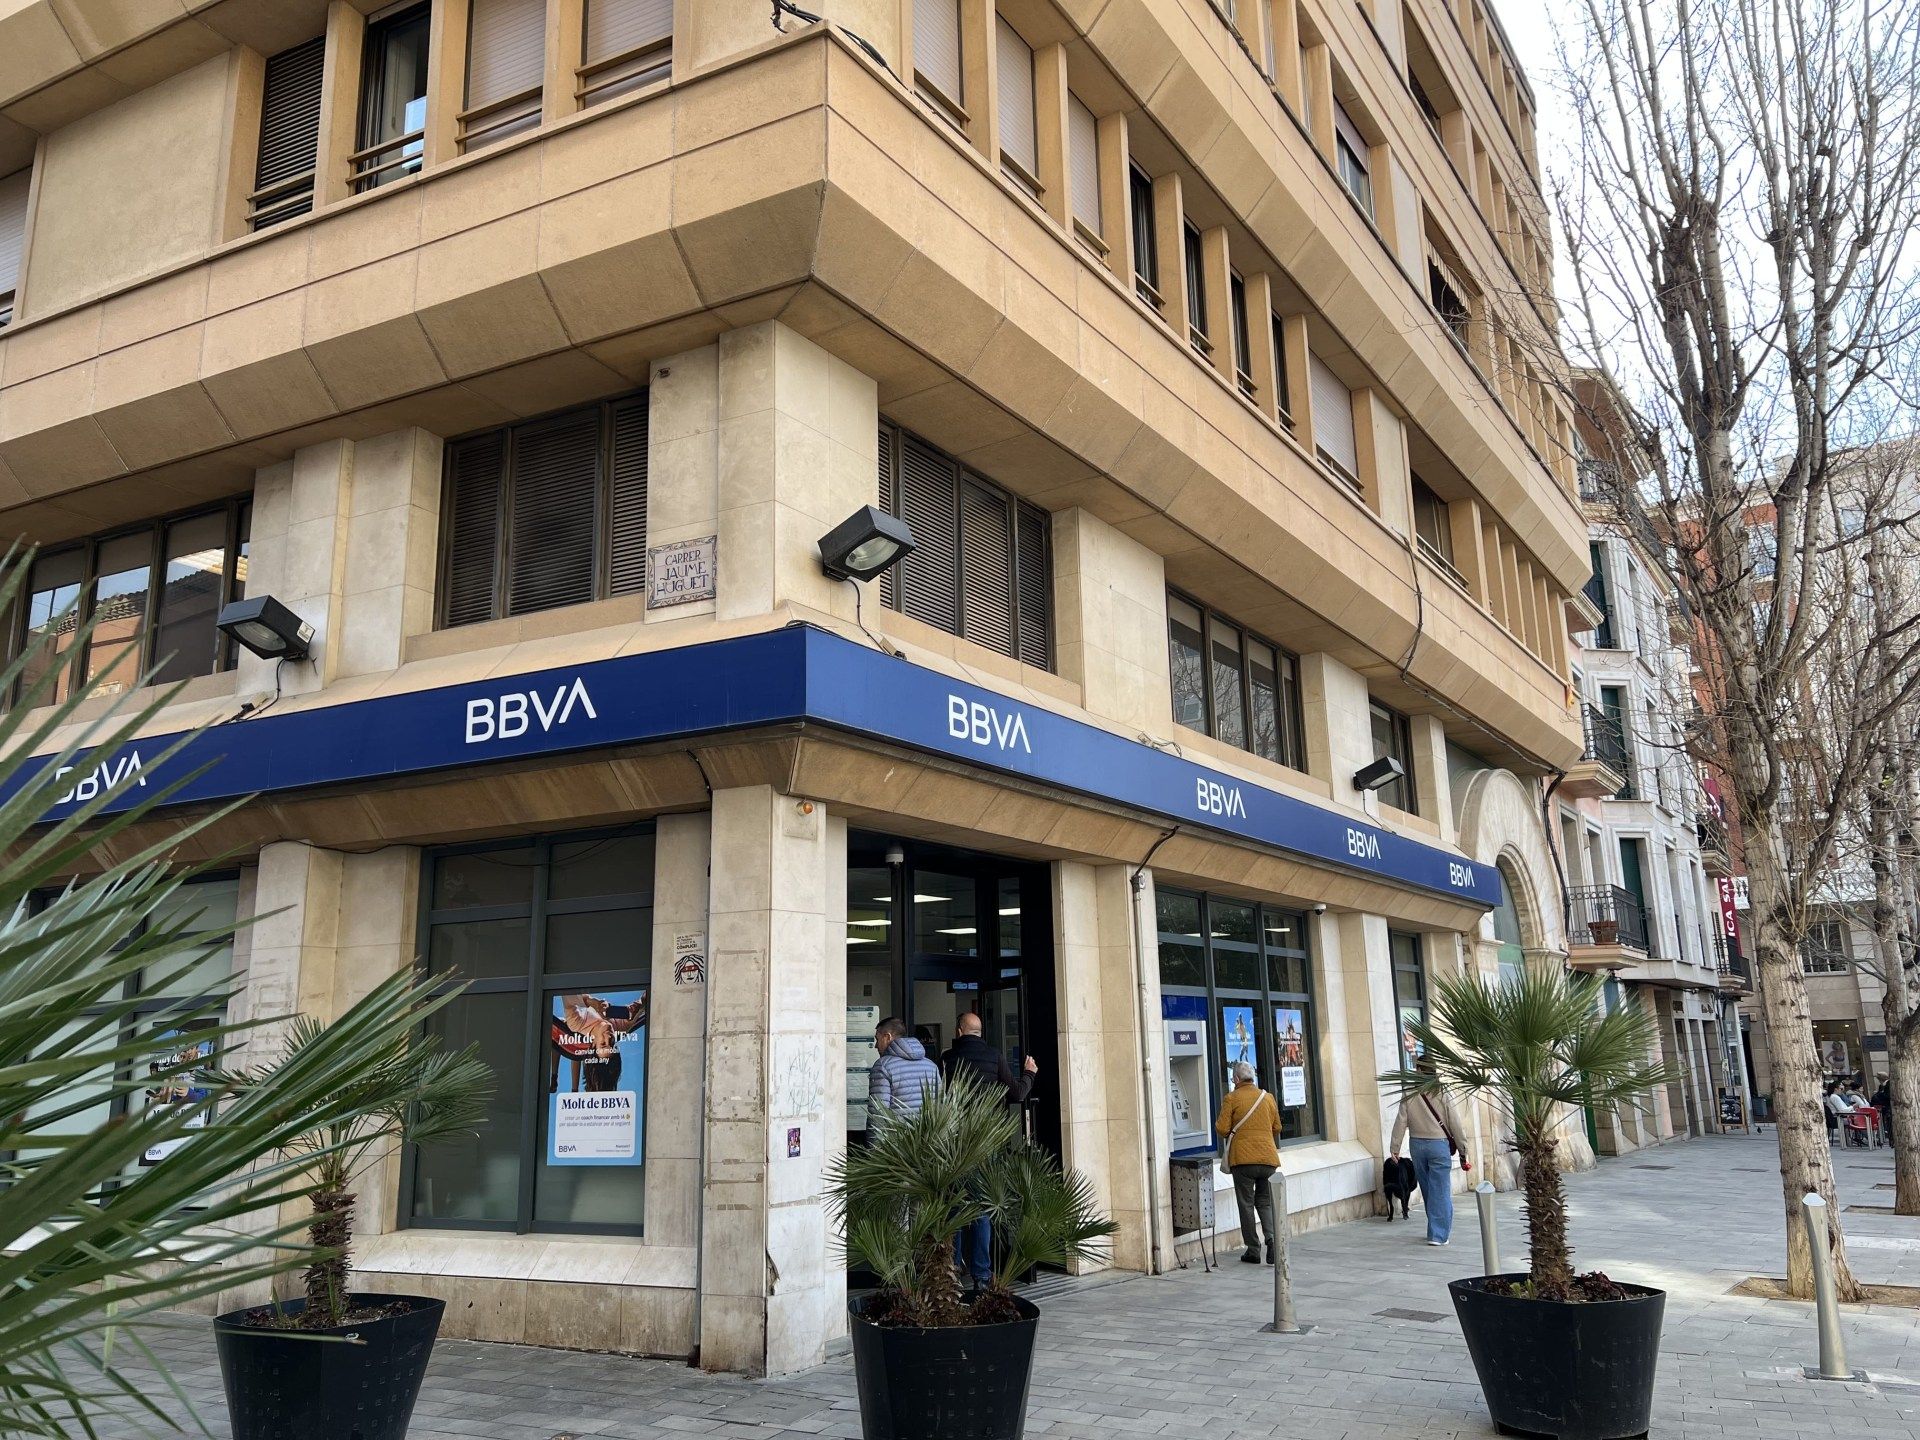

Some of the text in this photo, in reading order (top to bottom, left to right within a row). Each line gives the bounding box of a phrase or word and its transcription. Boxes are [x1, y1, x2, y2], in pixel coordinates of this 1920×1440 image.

[665, 549, 701, 566] CARRER
[660, 561, 707, 581] JAUME
[656, 574, 709, 596] HUGUET
[465, 676, 597, 744] BBVA
[948, 694, 1032, 754] BBVA
[1196, 777, 1247, 819] BBVA
[1347, 827, 1381, 860] BBVA
[1449, 862, 1475, 888] BBVA
[558, 1034, 582, 1045] Molt
[582, 1033, 595, 1044] de
[599, 1057, 610, 1065] any
[561, 1097, 630, 1109] Molt de BBVA
[558, 1145, 577, 1153] BBVA
